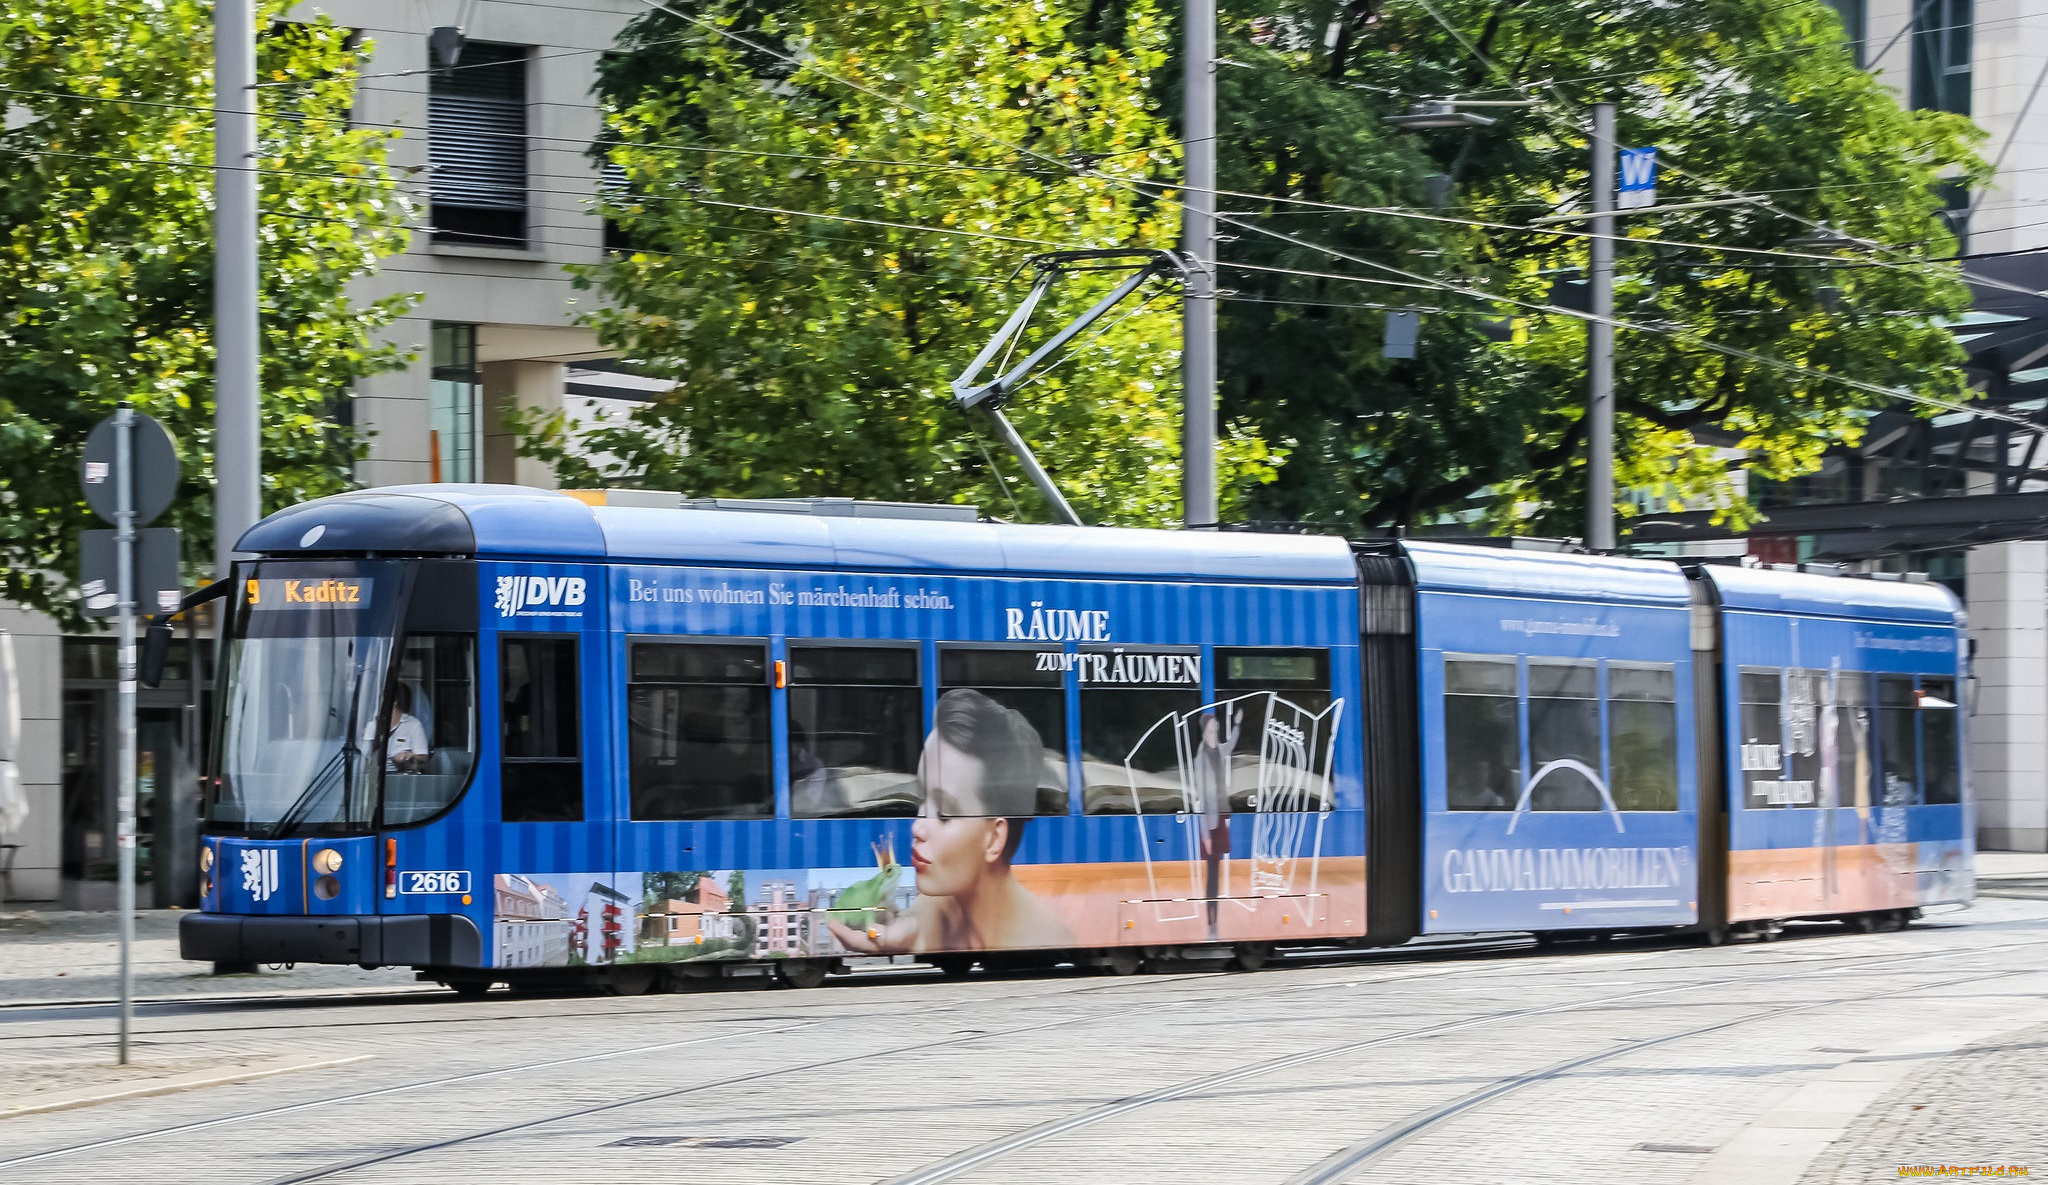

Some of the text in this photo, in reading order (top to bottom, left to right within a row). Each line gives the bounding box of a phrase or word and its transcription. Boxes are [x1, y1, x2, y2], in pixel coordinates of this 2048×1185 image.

[1621, 152, 1656, 186] W
[247, 579, 360, 604] 9 Kaditz
[525, 576, 587, 606] DVB
[628, 578, 955, 610] Bei uns wohnen Sie märchenhaft schön.
[1005, 600, 1112, 642] RÄUME
[1035, 648, 1202, 684] ZUM TRÄUMEN
[411, 872, 460, 892] 2616
